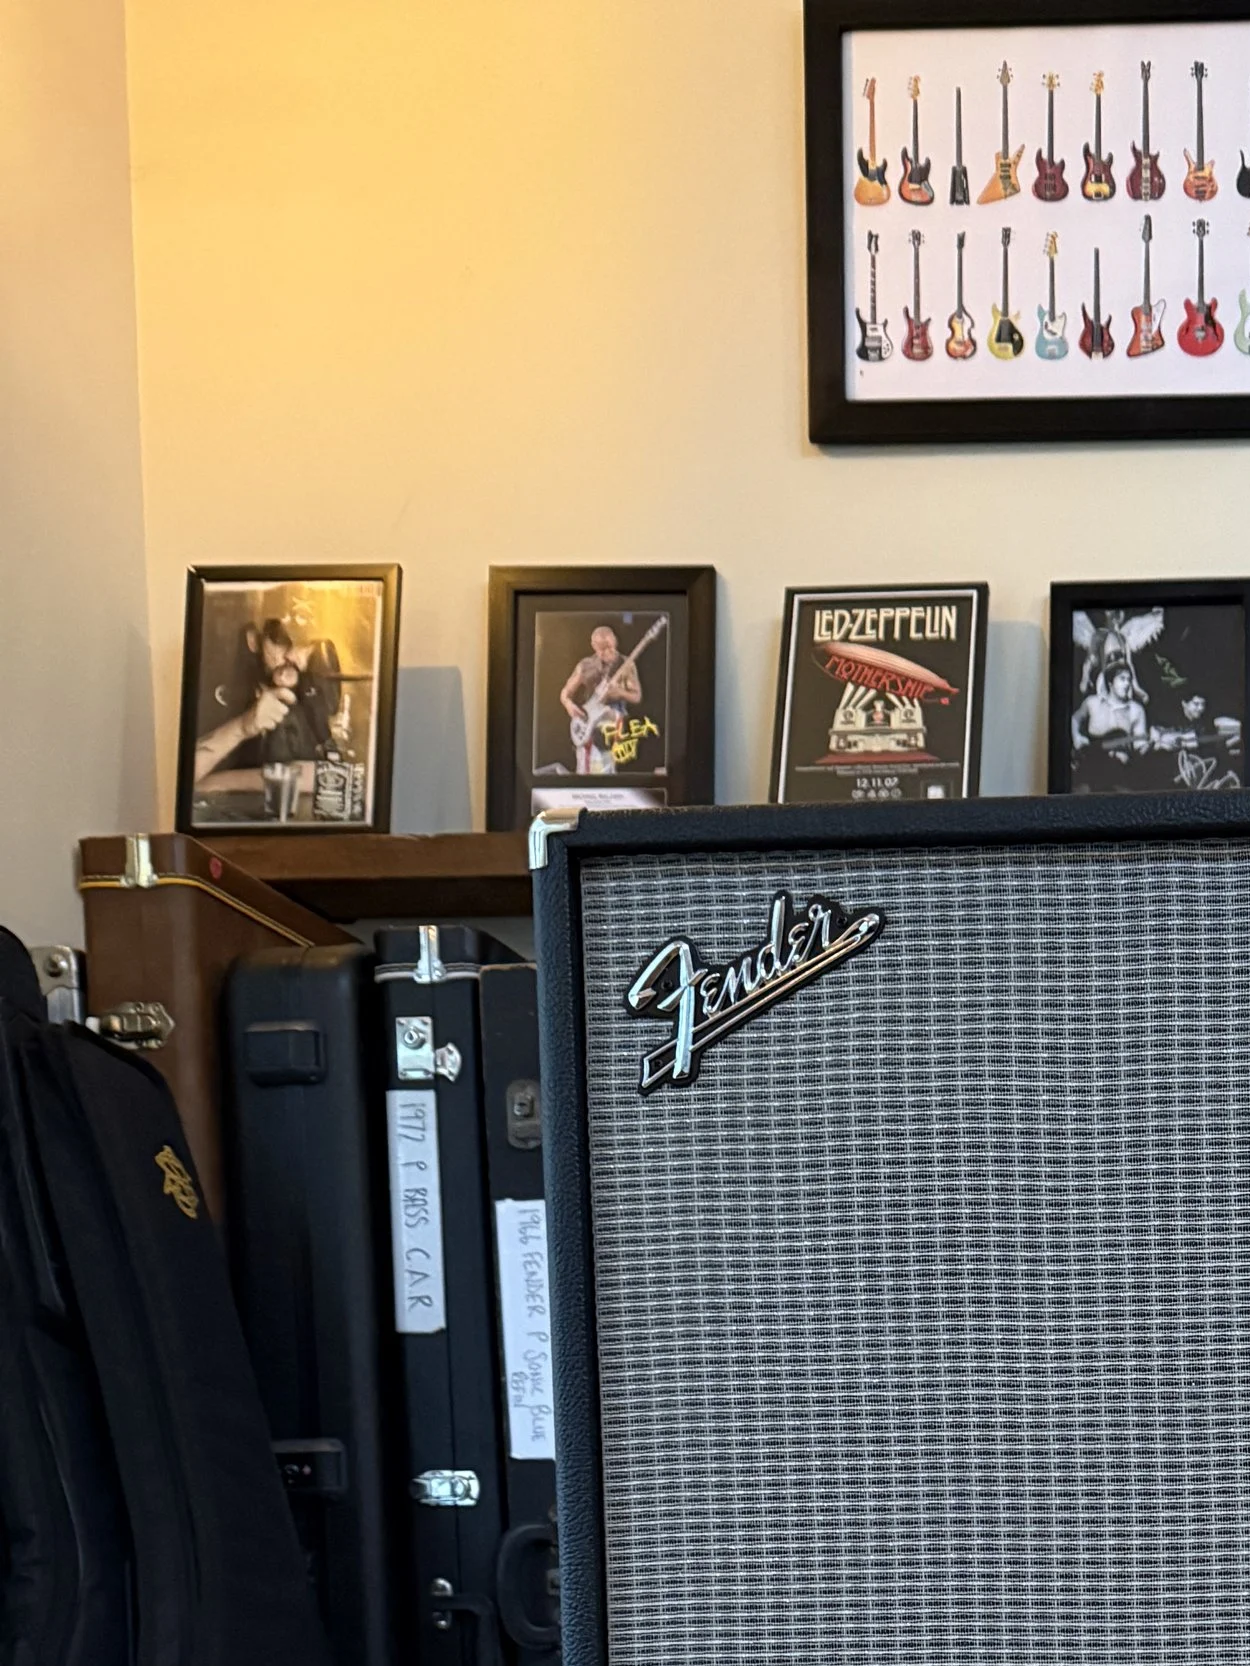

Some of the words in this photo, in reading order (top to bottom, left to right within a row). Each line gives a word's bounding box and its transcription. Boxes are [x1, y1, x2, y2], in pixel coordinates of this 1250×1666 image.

[824, 655, 936, 702] MOTHERSHIP
[628, 894, 878, 1088] Fender
[400, 1161, 428, 1173] P
[402, 1188, 430, 1229] BASS
[518, 1208, 544, 1246] 1966
[521, 1251, 545, 1318] FENDER
[527, 1331, 549, 1343] P
